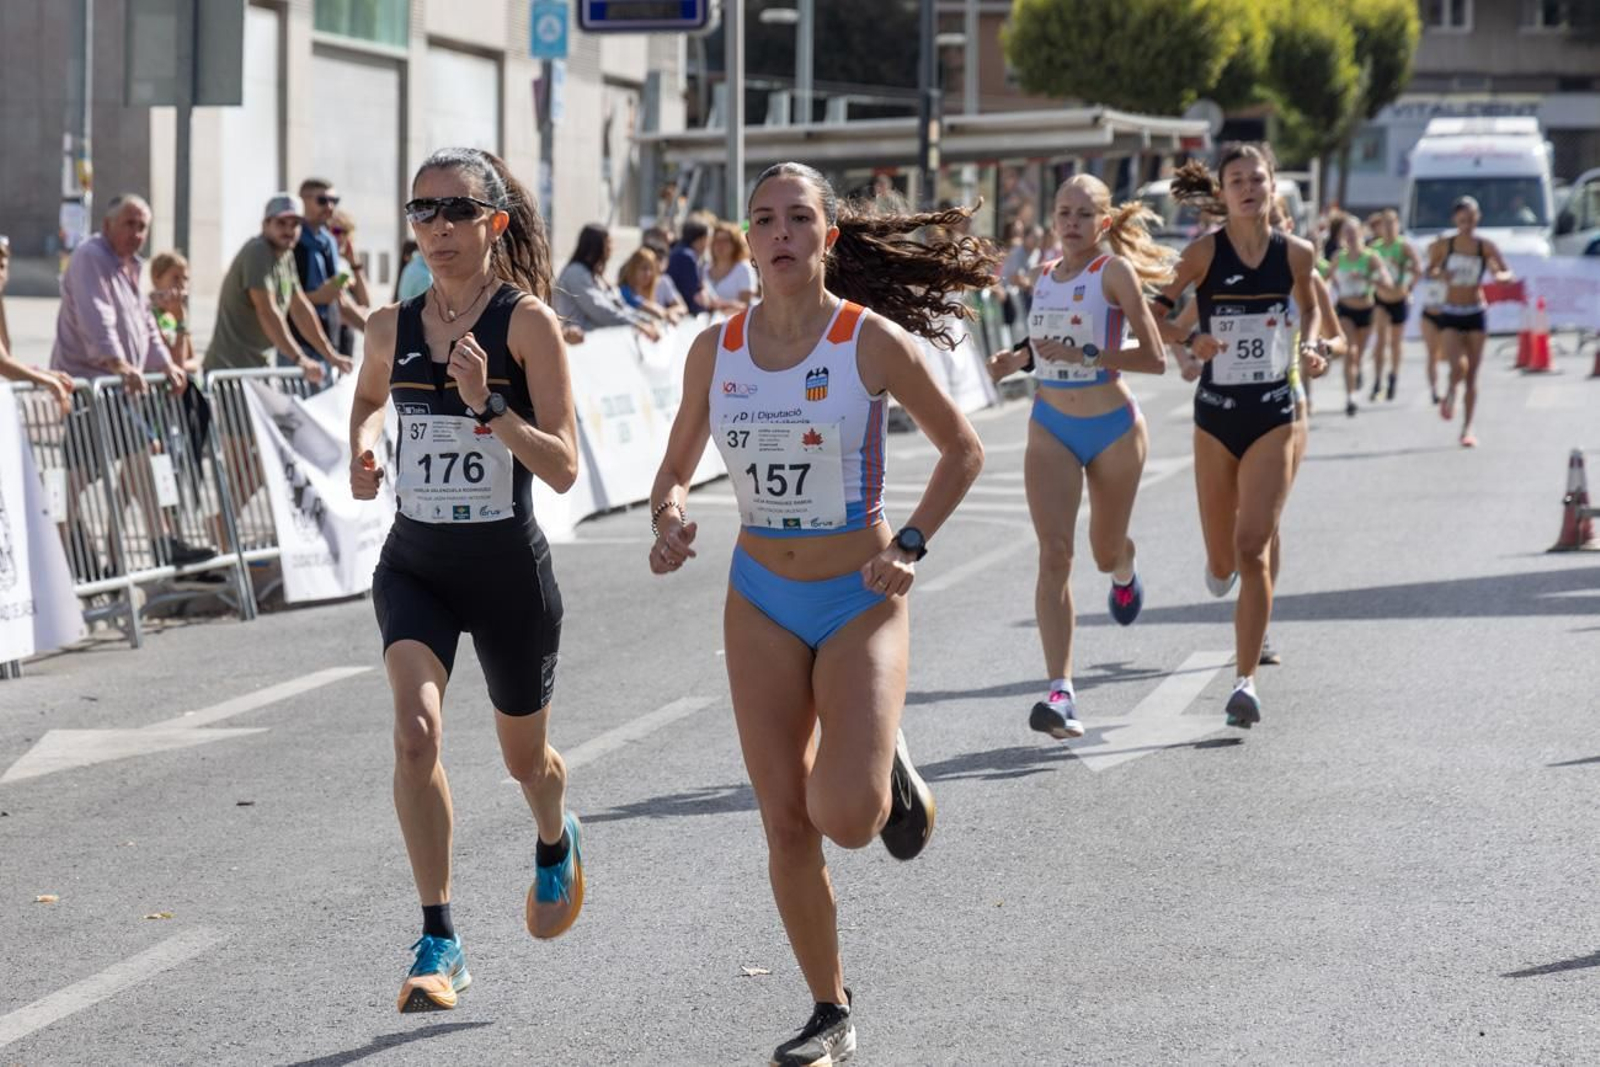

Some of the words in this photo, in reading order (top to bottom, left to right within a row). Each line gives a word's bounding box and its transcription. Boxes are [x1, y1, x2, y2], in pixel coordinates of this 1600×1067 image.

[1219, 320, 1235, 332] 37
[1236, 338, 1265, 359] 58
[757, 408, 802, 420] Diputació
[410, 422, 428, 440] 37
[726, 430, 751, 448] 37
[417, 451, 485, 485] 176
[745, 462, 812, 497] 157
